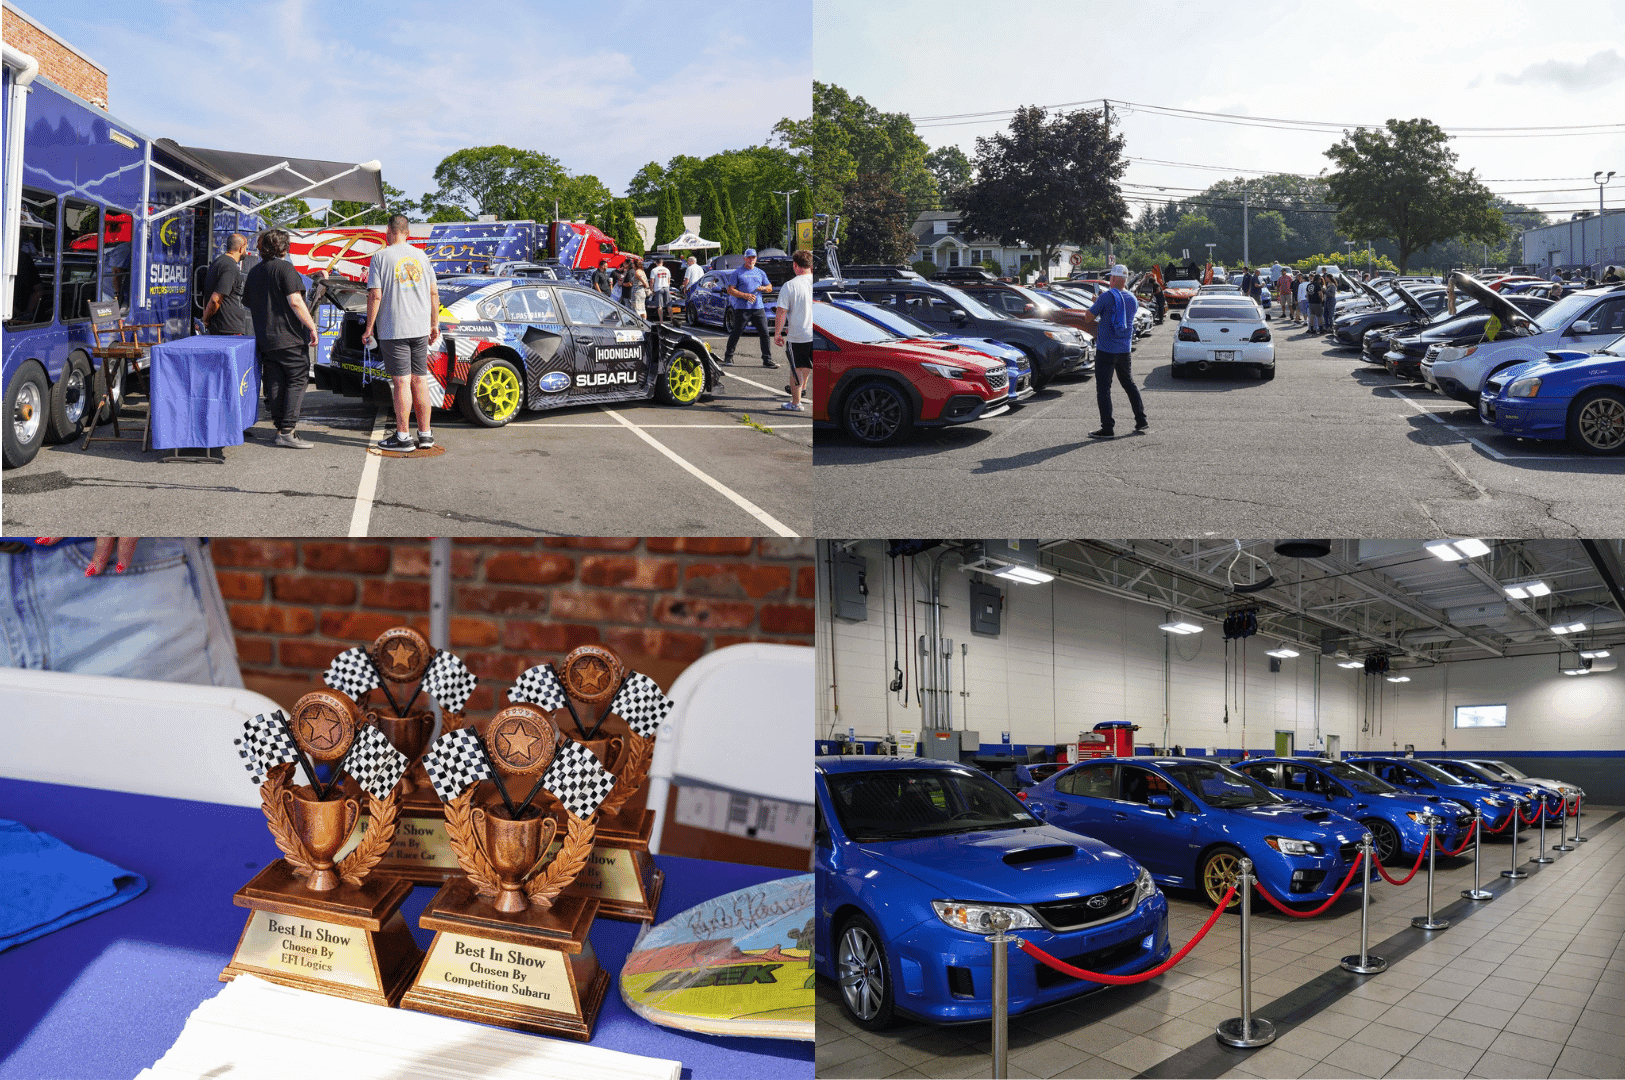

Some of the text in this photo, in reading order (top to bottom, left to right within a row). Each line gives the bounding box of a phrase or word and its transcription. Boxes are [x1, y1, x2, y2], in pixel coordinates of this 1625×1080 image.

[150, 263, 187, 283] SUBARU
[459, 325, 493, 333] YOKOHAMA
[576, 371, 637, 387] SUBARU
[403, 823, 434, 836] Show
[409, 839, 420, 848] By
[396, 849, 418, 859] Race
[421, 850, 436, 860] Car
[588, 851, 616, 865] how
[268, 919, 351, 946] Best In Show
[282, 939, 334, 959] Chosen By
[455, 941, 546, 969] Best In Show
[281, 953, 332, 972] EFI Logics
[470, 962, 527, 982] Chosen By
[444, 972, 551, 1001] Competition Subaru
